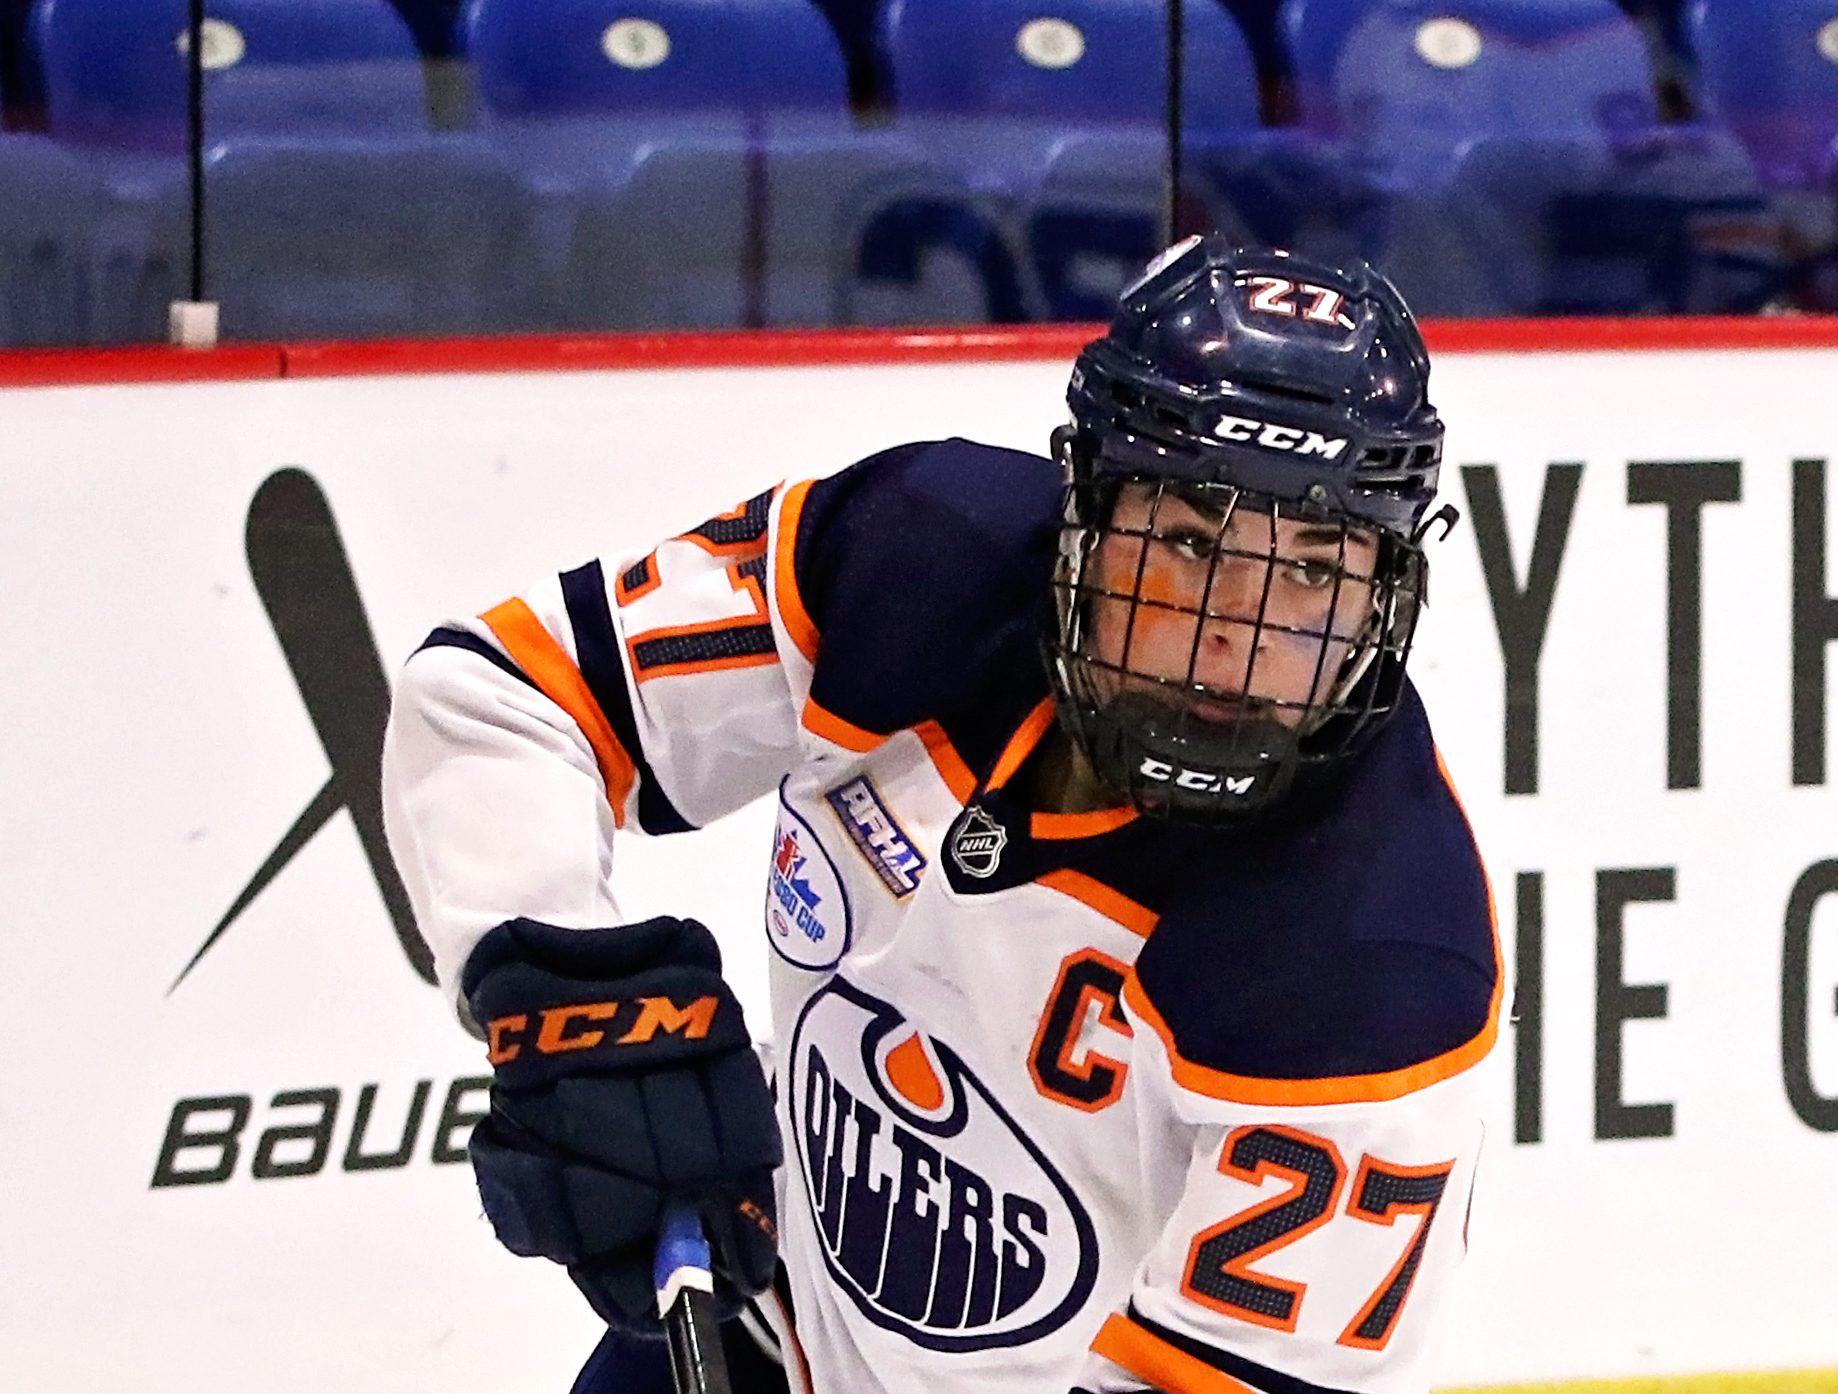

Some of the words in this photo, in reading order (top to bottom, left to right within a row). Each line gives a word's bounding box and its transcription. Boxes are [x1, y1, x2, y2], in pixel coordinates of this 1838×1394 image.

[1247, 275, 1346, 326] 27
[1213, 413, 1348, 461] CCM
[1139, 756, 1255, 796] CCM
[959, 836, 996, 852] NHL
[485, 995, 720, 1067] CCM
[1026, 945, 1134, 1115] C
[147, 1075, 497, 1191] BAUE
[804, 1043, 1048, 1330] OILERS
[1180, 1122, 1458, 1353] 27
